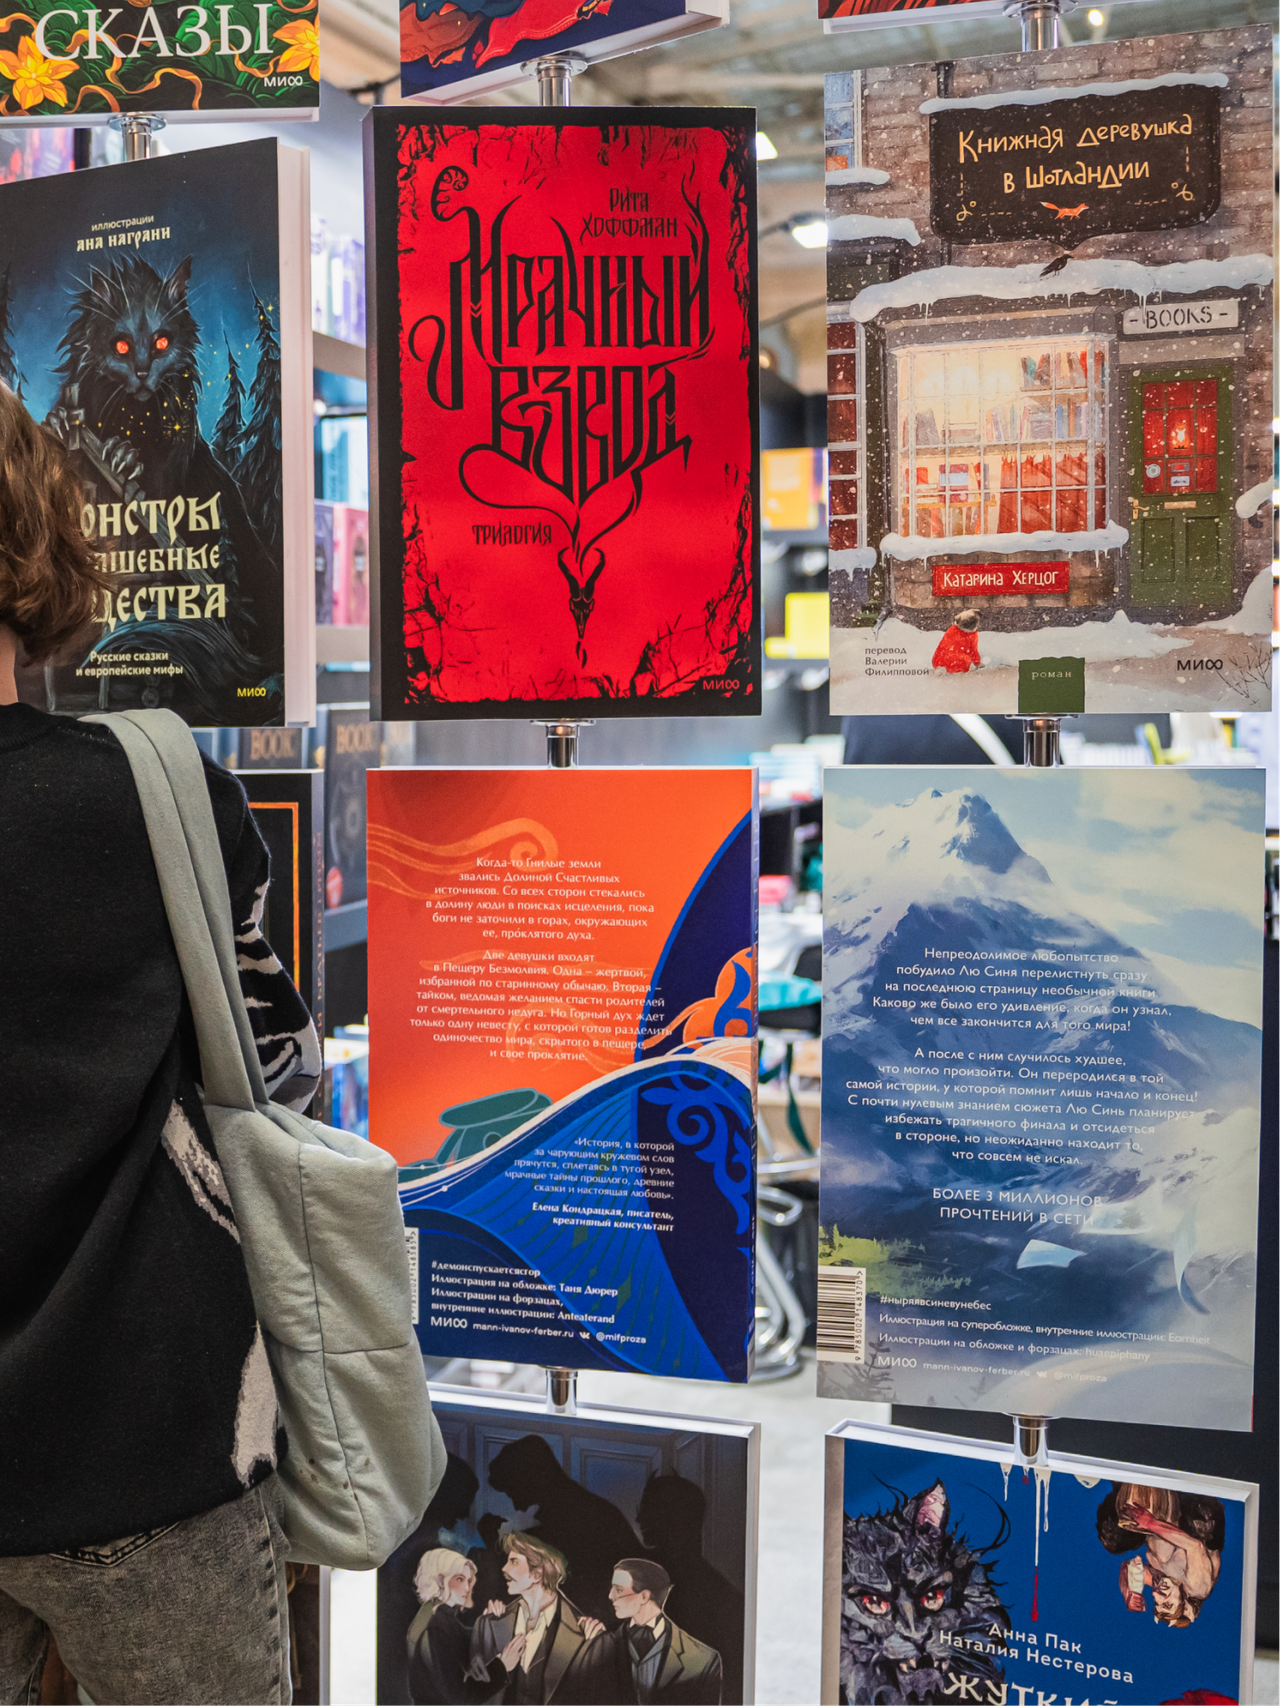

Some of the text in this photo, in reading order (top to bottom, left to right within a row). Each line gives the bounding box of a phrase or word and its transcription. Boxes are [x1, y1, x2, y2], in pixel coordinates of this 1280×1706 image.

[34, 3, 275, 61] СКАЗЫ
[959, 126, 1064, 164] Книжная
[91, 214, 155, 232] иллюстрации
[80, 491, 221, 545] ОНСТРЫ
[943, 572, 1004, 588] Катарина
[90, 651, 169, 664] Русские сказки
[864, 647, 908, 656] перевод
[864, 656, 908, 666] Валерии
[75, 664, 184, 677] и европейские мифы
[864, 667, 930, 677] Филипповой
[1031, 671, 1072, 680] роман
[476, 857, 601, 868] Когда-то Гнилые земли
[458, 871, 620, 883] звались Долиной Счастливых
[434, 885, 645, 898] источников. Со всех сторон стекались
[482, 949, 594, 962] Две девушки входят
[924, 947, 1118, 962] Непреодолимое любопытство
[896, 963, 1147, 983] побудило Лю Синя перелистнуть сразу
[884, 982, 1159, 998] на последнюю страницу необычной книги.
[416, 991, 665, 1007] тайком, ведомая желанием спасти родителей
[409, 1018, 445, 1027] только
[447, 1020, 474, 1030] одну
[476, 1021, 521, 1032] невесту,
[533, 1023, 578, 1033] которой
[581, 1025, 611, 1033] готов
[614, 1026, 672, 1036] разделить
[432, 1033, 647, 1050] одиночество мира, скрытого в пещере,
[489, 1049, 588, 1061] и свое проклятие.
[884, 1113, 942, 1125] избежать
[946, 1117, 1016, 1129] трагичного
[1020, 1117, 1066, 1132] финала
[1082, 1123, 1155, 1134] отсидеться
[951, 1151, 1083, 1165] что совсем не искал.
[504, 1170, 674, 1187] мрачные тайны прошлого, древние
[533, 1184, 566, 1192] сказки
[576, 1187, 628, 1196] настоящая
[932, 1187, 1101, 1206] БОЛЕЕ 3 МИЛЛИОНОВ
[531, 1201, 674, 1221] Елена Кондрацкая, писатель,
[939, 1206, 1094, 1225] ПРОЧТЕНИЙ В СЕТИ
[552, 1217, 674, 1231] креативный консультант
[431, 1273, 618, 1297] Иллюстрация на обложке: Таня Дюрер
[431, 1287, 563, 1307] Иллюстрации на форзацах,
[430, 1302, 486, 1313] внутренние
[487, 1307, 555, 1319] иллюстрации:
[879, 1332, 950, 1347] Иллюстрации
[968, 1338, 1014, 1351] обложке
[1027, 1342, 1081, 1355] форзацах:
[988, 1622, 1082, 1654] Анна Пак
[939, 1629, 1134, 1684] Наталия Нестерова
